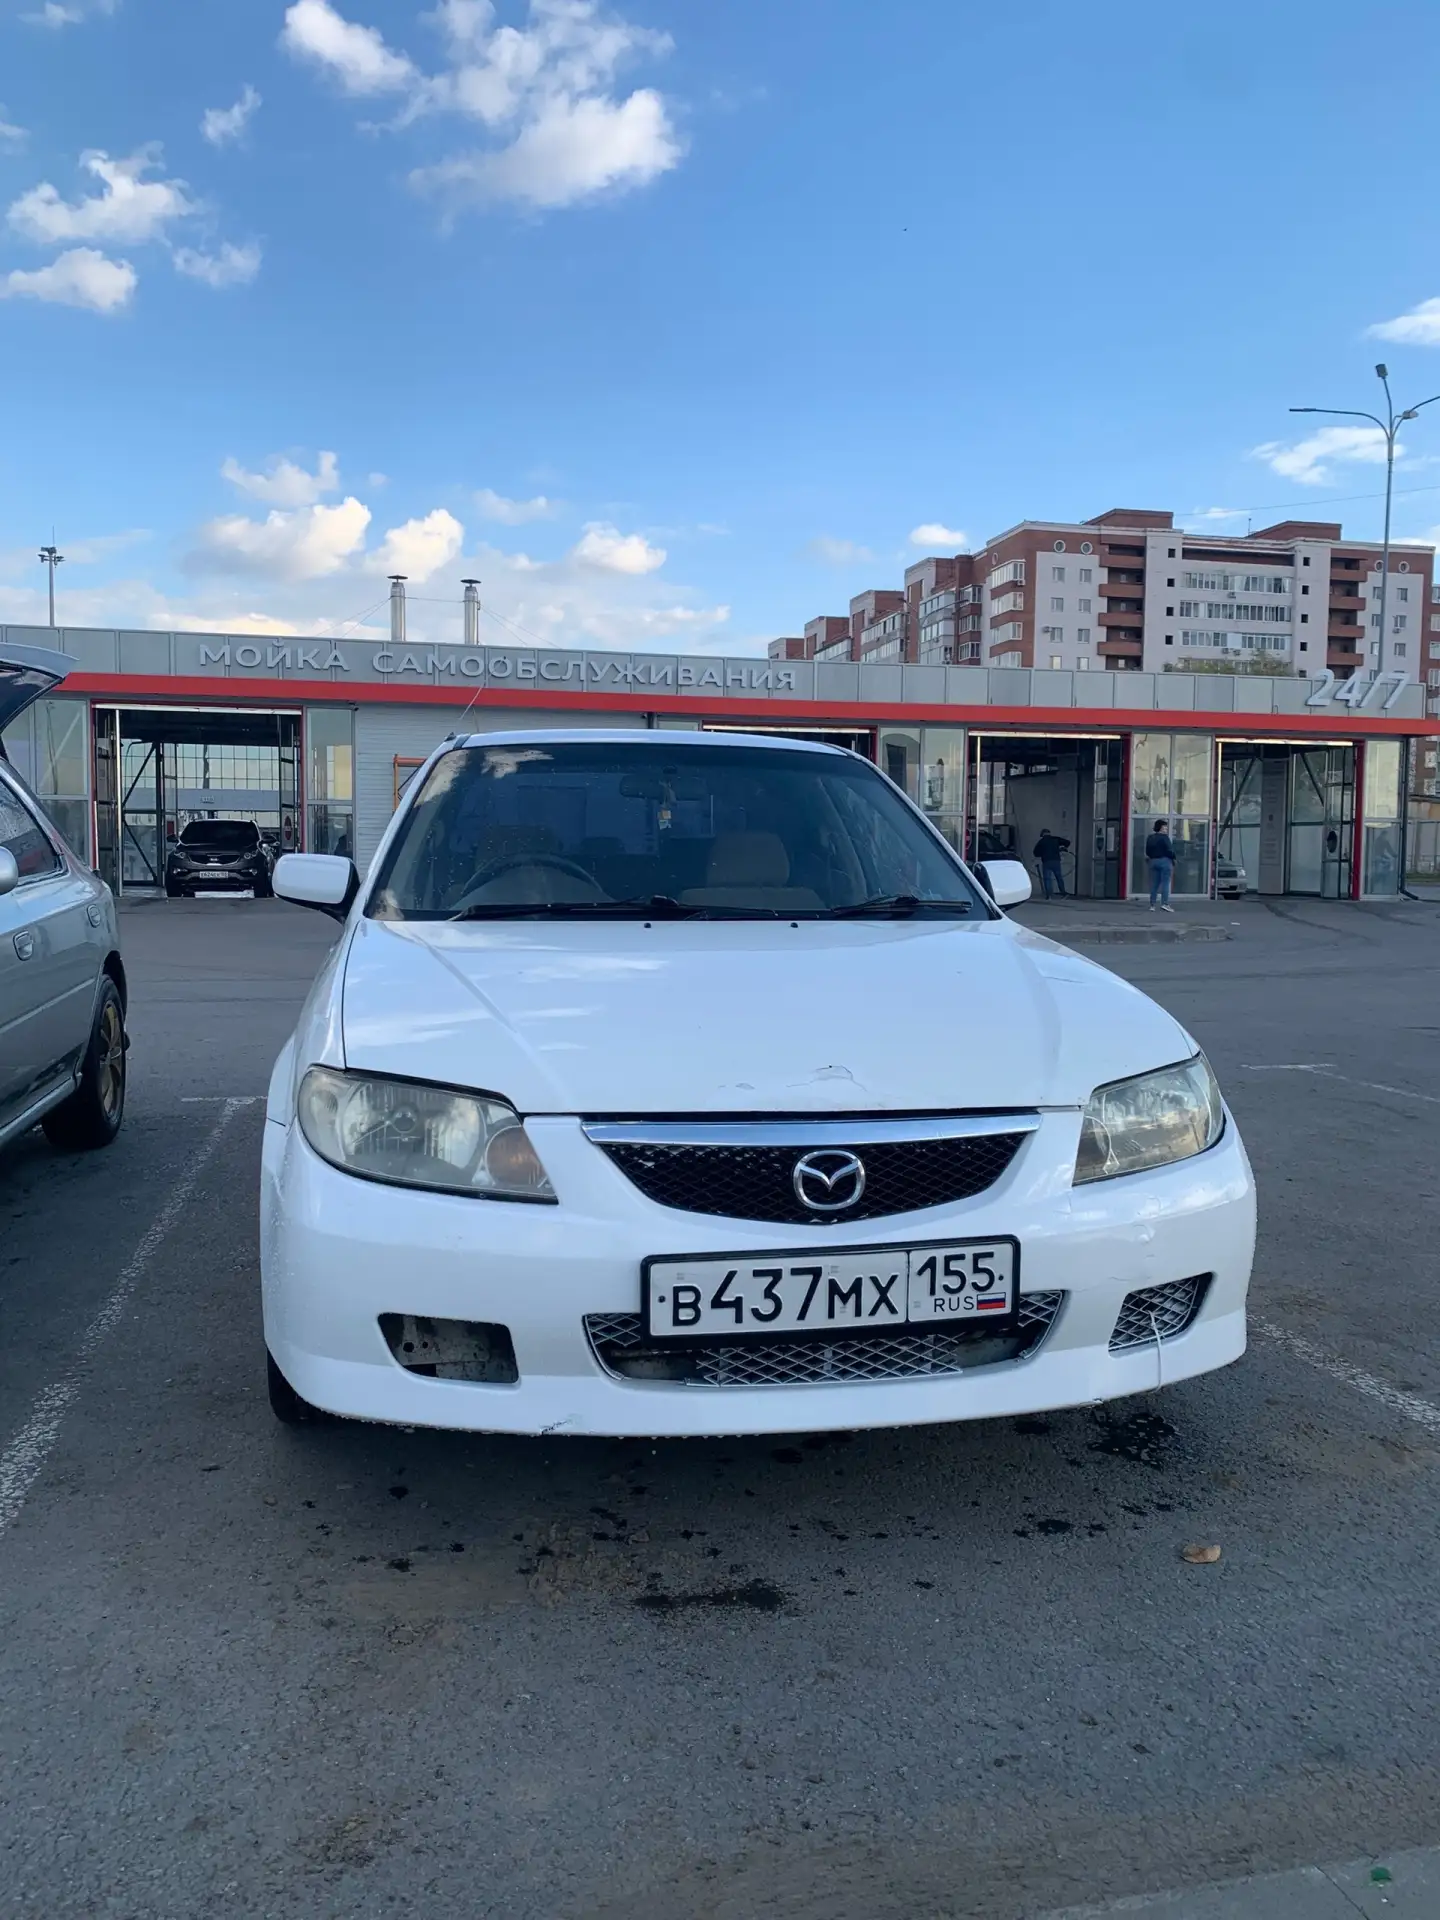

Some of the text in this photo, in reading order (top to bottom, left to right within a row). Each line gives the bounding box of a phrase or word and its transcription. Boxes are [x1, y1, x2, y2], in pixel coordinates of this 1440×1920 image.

[199, 639, 796, 690] МОЙКА САМООБСЛУЖИВАНИЯ
[1305, 668, 1411, 709] 24/7
[916, 1251, 995, 1297] 155
[933, 1295, 975, 1313] RUS
